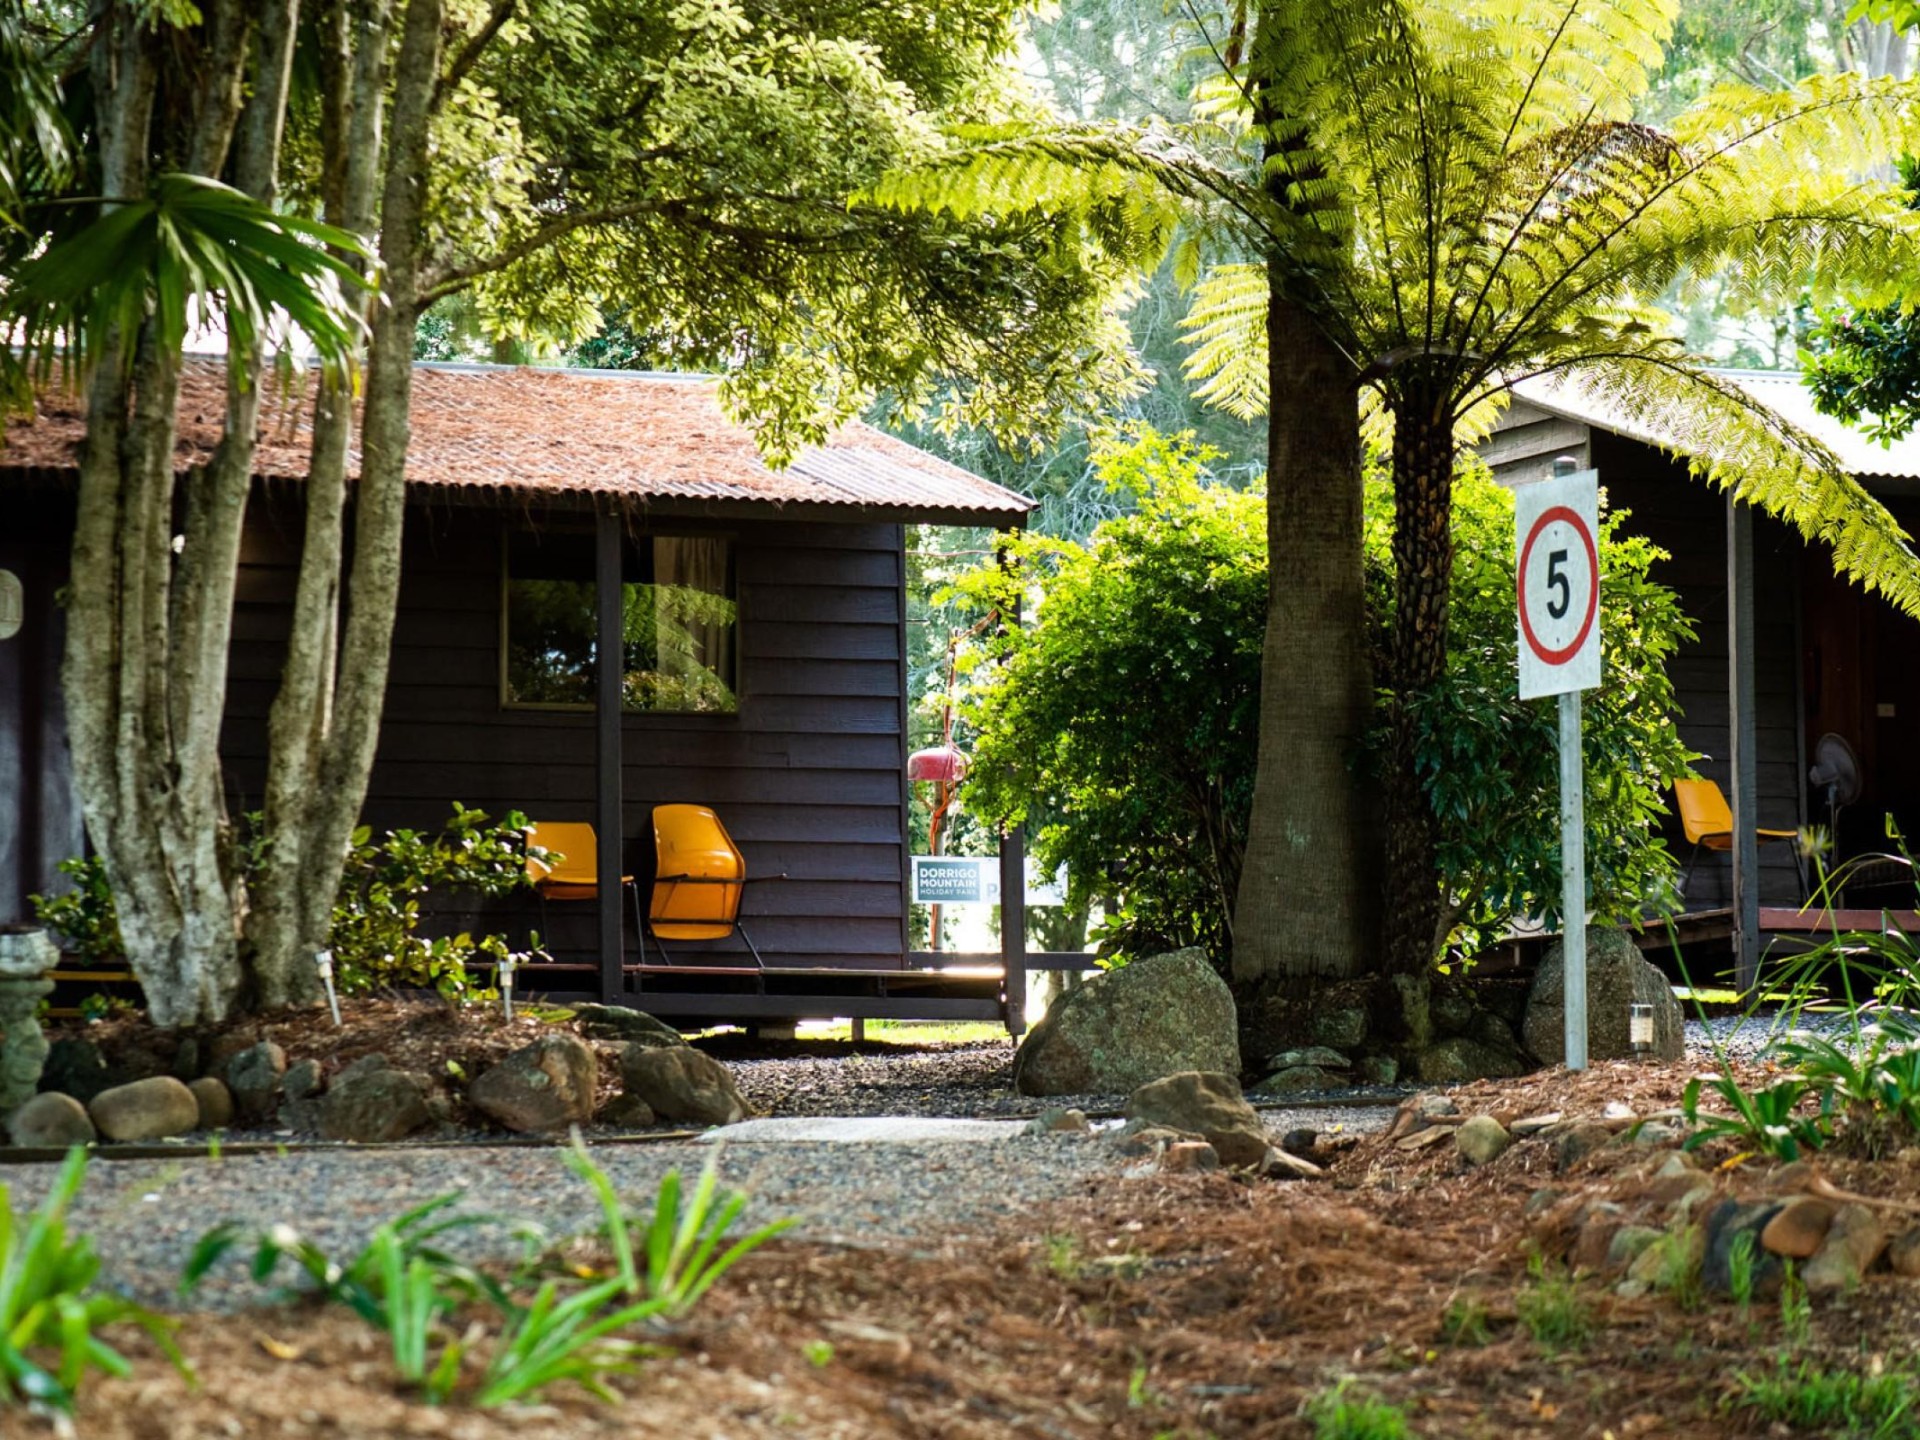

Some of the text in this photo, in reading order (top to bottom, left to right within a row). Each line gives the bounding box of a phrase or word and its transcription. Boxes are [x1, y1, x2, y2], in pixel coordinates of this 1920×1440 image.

[1547, 549, 1570, 619] 5
[920, 868, 977, 878] DORRIGO
[920, 879, 976, 887] MOUNTAIN
[920, 888, 955, 896] HOLIDAY
